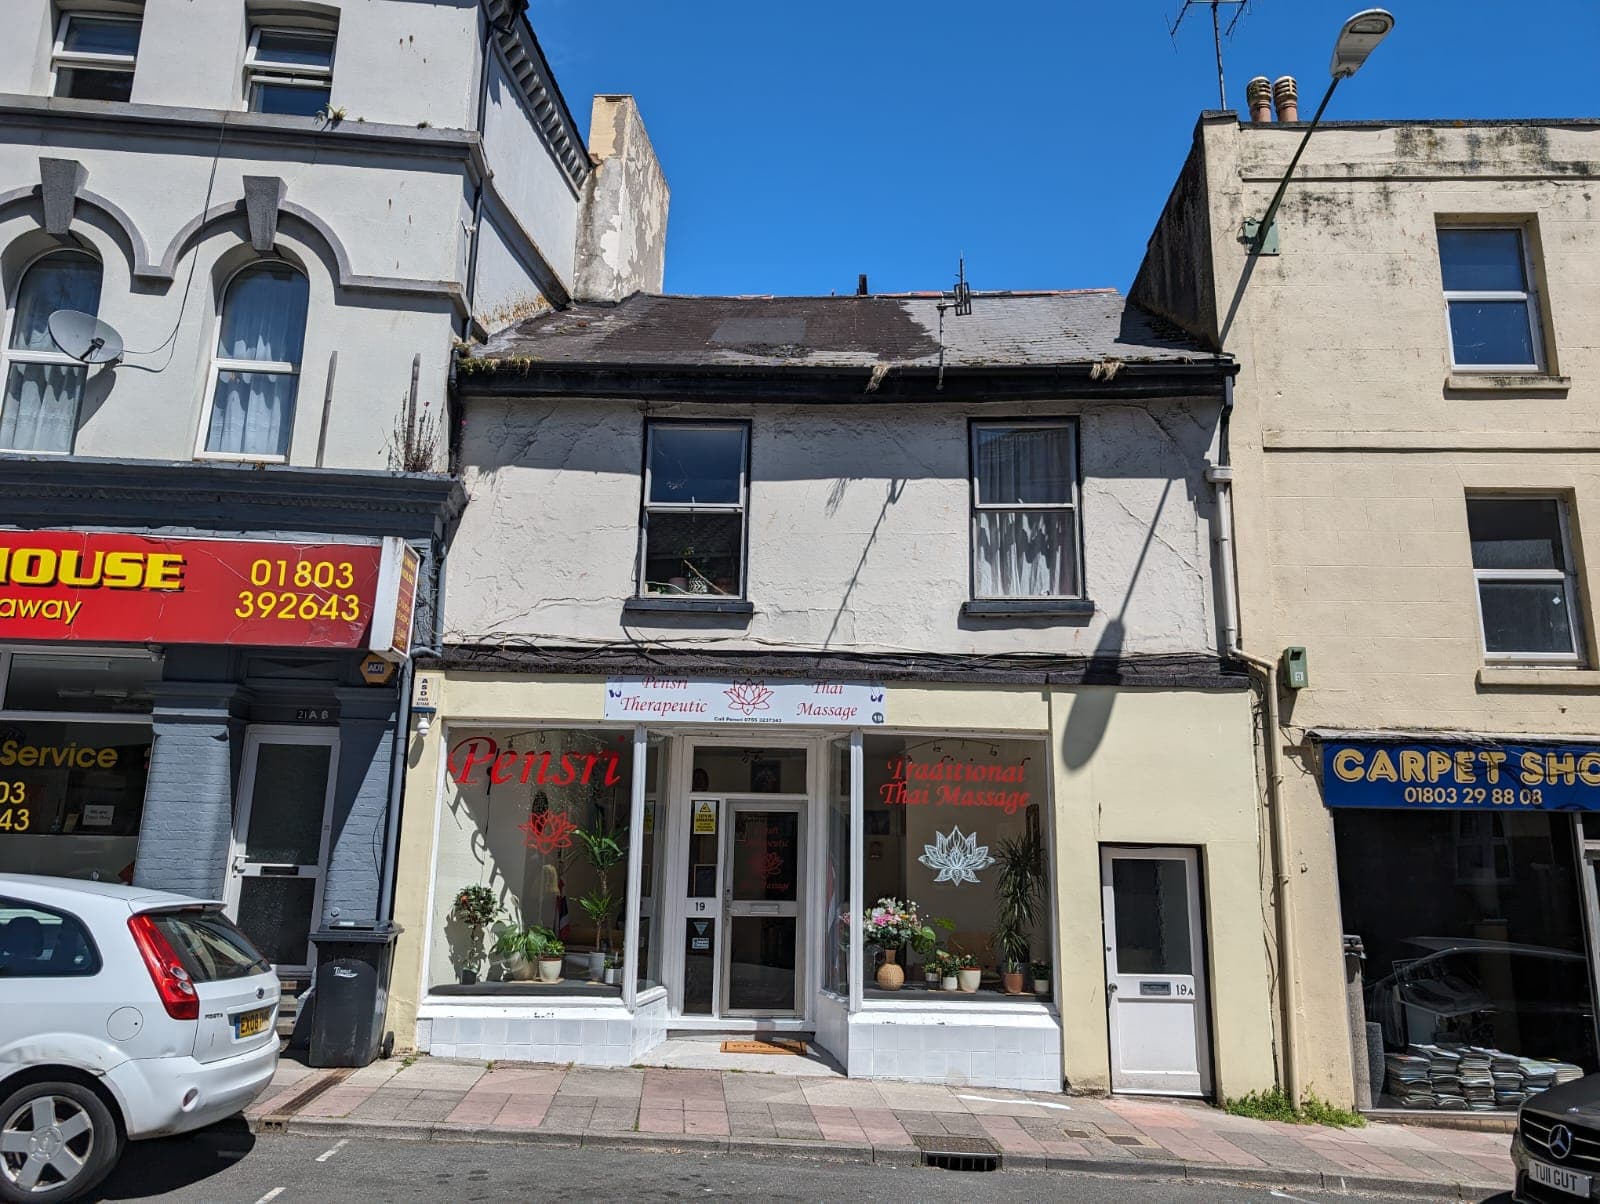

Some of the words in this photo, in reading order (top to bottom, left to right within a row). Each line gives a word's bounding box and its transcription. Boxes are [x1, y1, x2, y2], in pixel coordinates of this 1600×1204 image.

[0, 547, 184, 590] OUSE
[250, 559, 354, 589] 01803
[235, 590, 360, 621] 392643
[367, 664, 385, 673] ADT
[641, 675, 688, 690] Pensri
[810, 680, 844, 695] Thai
[620, 695, 708, 716] Therapeutic
[796, 702, 858, 721] Massage
[0, 739, 118, 768] Service
[447, 736, 626, 787] Pensri
[1333, 748, 1507, 784] CARPET
[887, 755, 1031, 783] Traditional
[880, 780, 931, 806] Thai
[936, 785, 1031, 815] Massage
[1404, 786, 1457, 804] 01803
[1462, 788, 1487, 805] 29
[1491, 789, 1515, 805] 88
[1519, 788, 1543, 805] 08
[695, 902, 706, 911] 19
[1553, 1169, 1577, 1192] GUT
